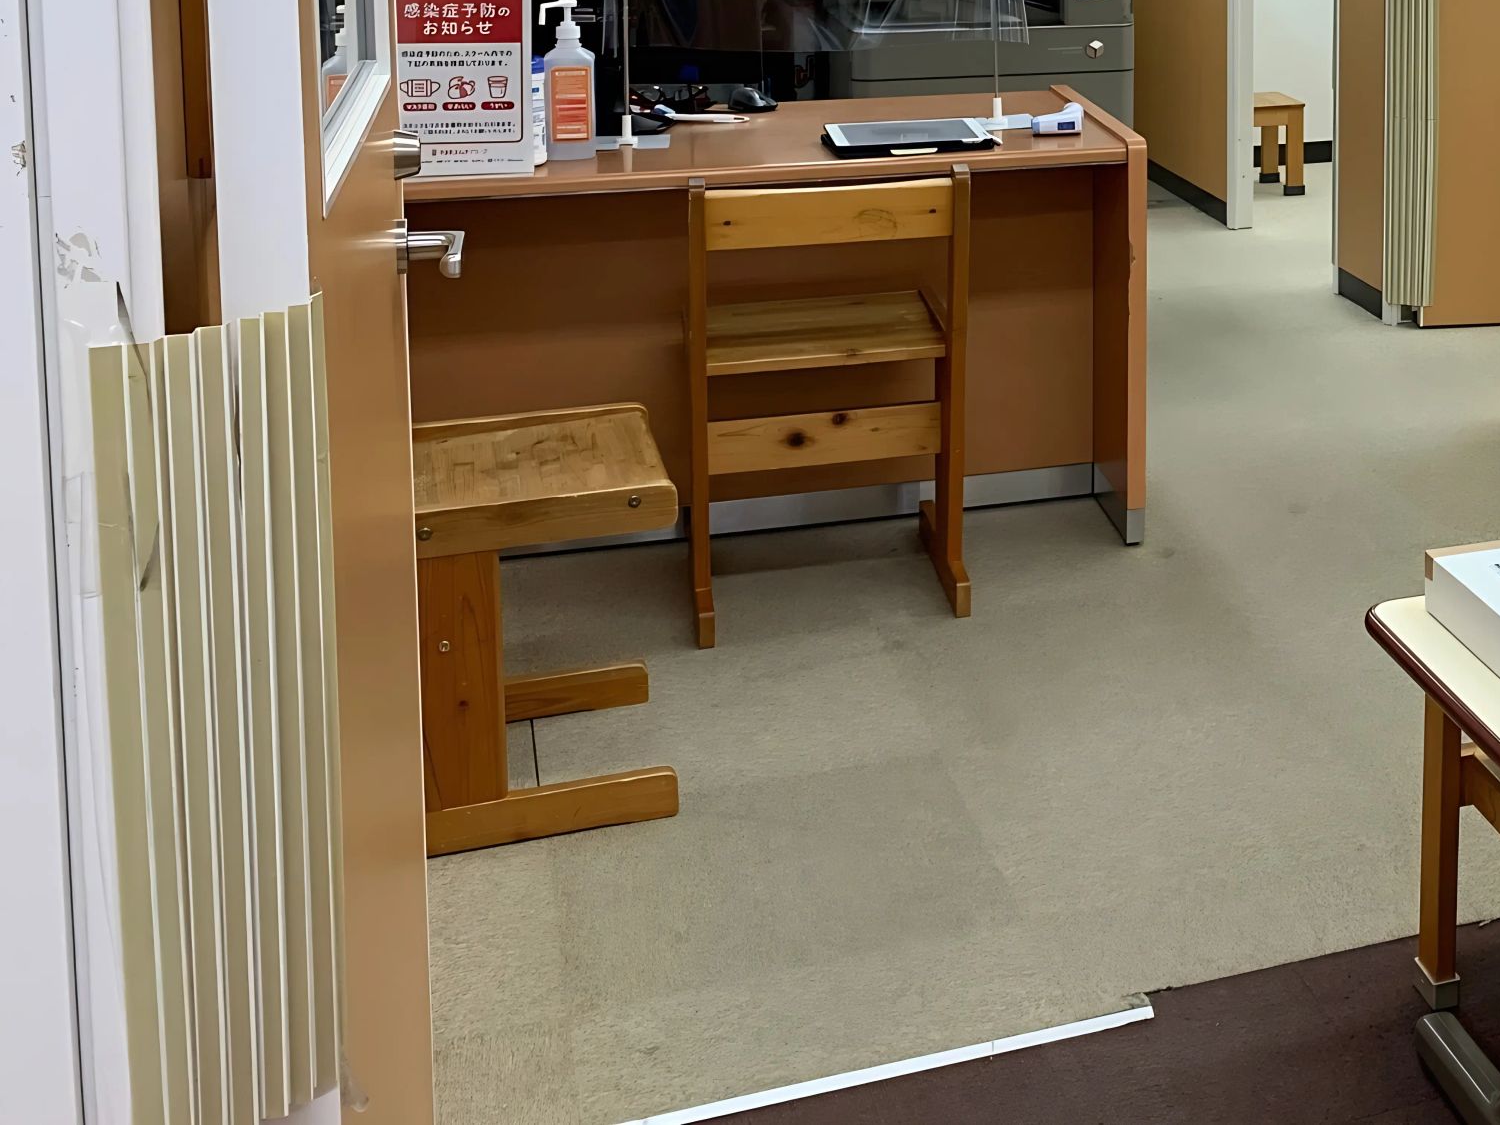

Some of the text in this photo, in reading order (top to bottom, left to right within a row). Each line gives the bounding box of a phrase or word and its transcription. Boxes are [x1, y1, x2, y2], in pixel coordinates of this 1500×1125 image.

[403, 2, 511, 19] 感染症予防の
[423, 20, 494, 36] お知らせ
